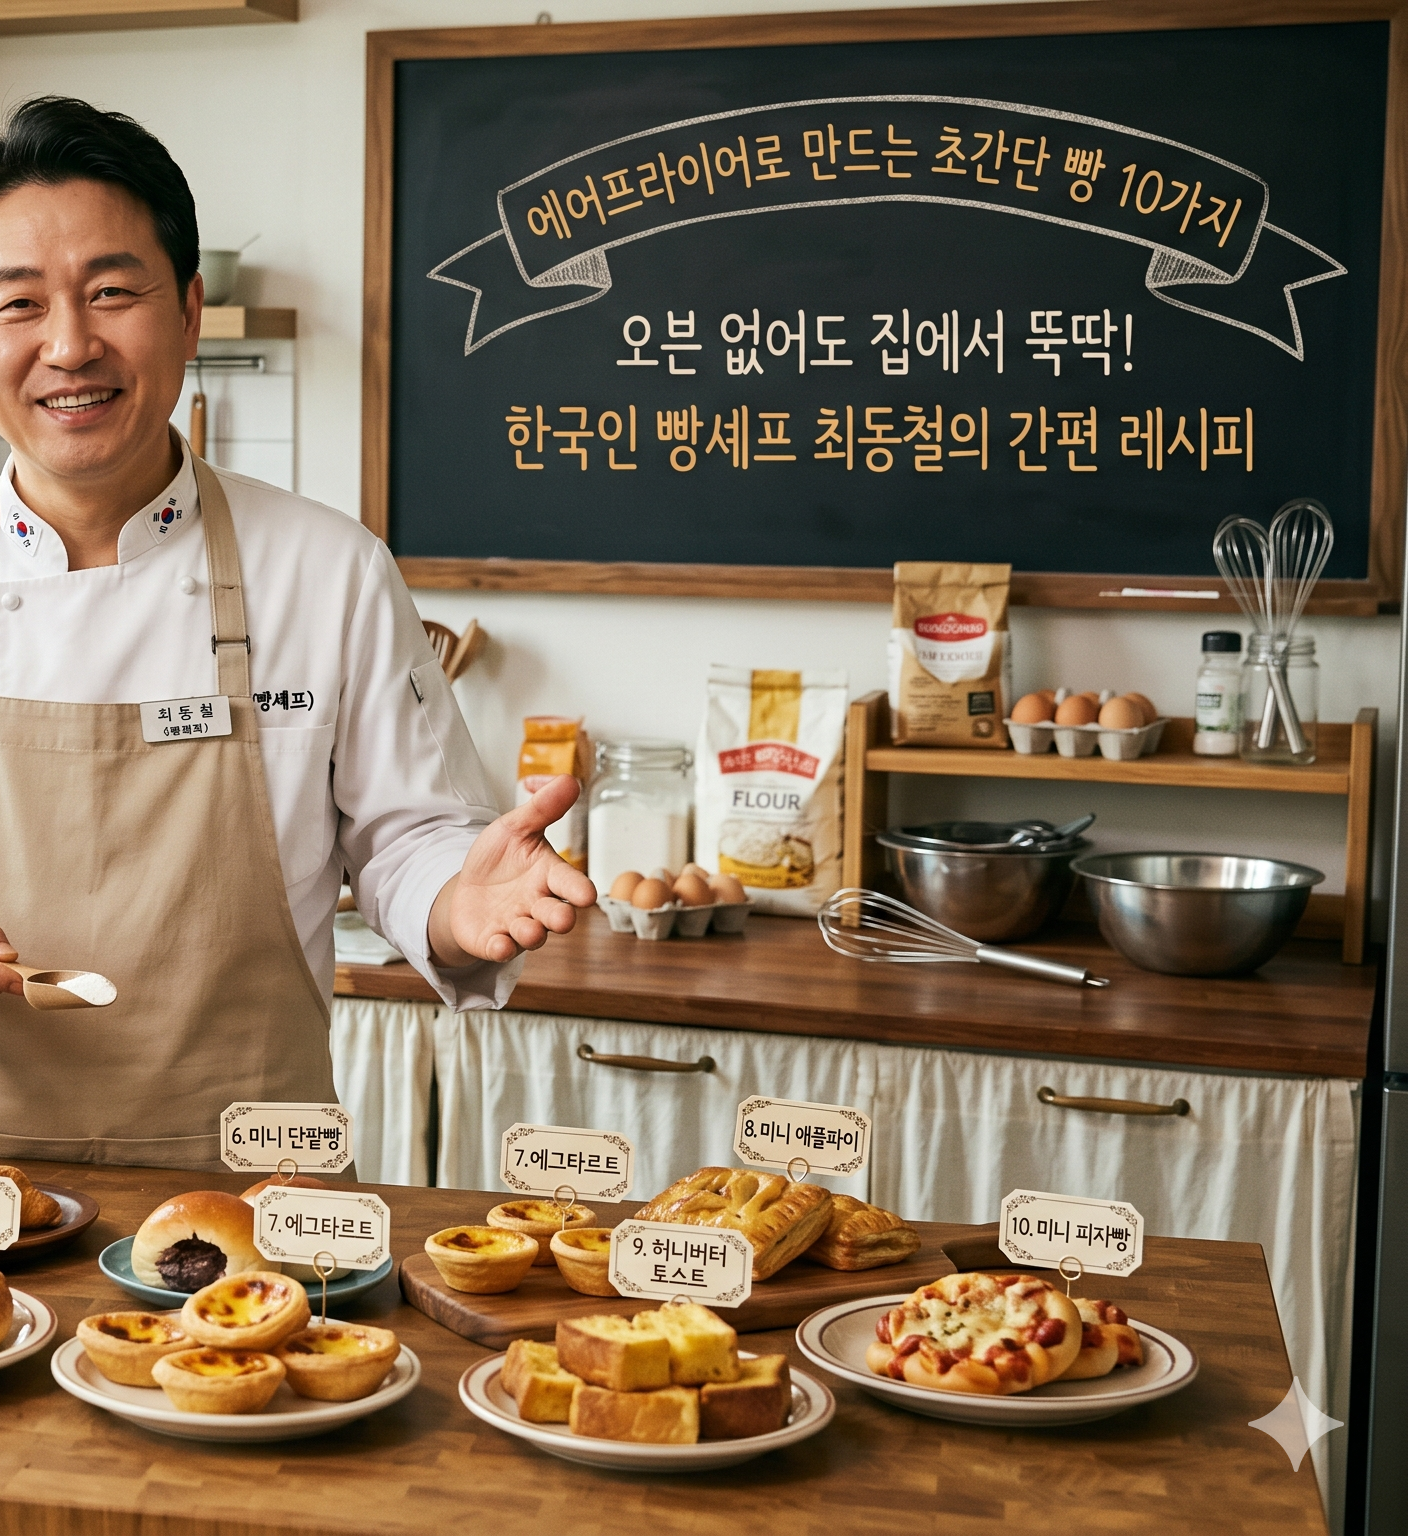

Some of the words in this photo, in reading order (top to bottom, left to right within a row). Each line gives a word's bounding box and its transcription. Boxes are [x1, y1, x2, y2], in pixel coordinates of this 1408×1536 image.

[526, 135, 791, 240] 에어프라이어로
[802, 123, 918, 181] 만드는
[930, 125, 1051, 193] 초간단
[1063, 147, 1107, 203] 빵
[1118, 162, 1242, 248] 10가지
[615, 309, 703, 375] 오븐
[720, 307, 854, 376] 없어도
[870, 308, 1004, 376] 집에서
[1025, 308, 1133, 377] 뚝딱!
[504, 404, 638, 472] 한국인
[656, 404, 797, 473] 빵셰프
[813, 404, 988, 473] 최동철의
[1009, 405, 1098, 472] 간편
[1120, 406, 1253, 472] 레시피
[732, 790, 801, 811] FLOUR
[249, 1125, 282, 1149] 미니
[288, 1126, 343, 1151] 단팥빵
[760, 1121, 791, 1144] 미니
[795, 1125, 859, 1153] 애플파이
[268, 1213, 281, 1233] 7.
[285, 1213, 375, 1240] 에그타르트
[1012, 1216, 1033, 1237] 10.
[1037, 1218, 1070, 1244] 미니
[1075, 1223, 1132, 1252] 피자빵
[632, 1237, 647, 1257] 9.
[651, 1238, 727, 1262] 허니버터
[649, 1262, 708, 1288] 토스트
